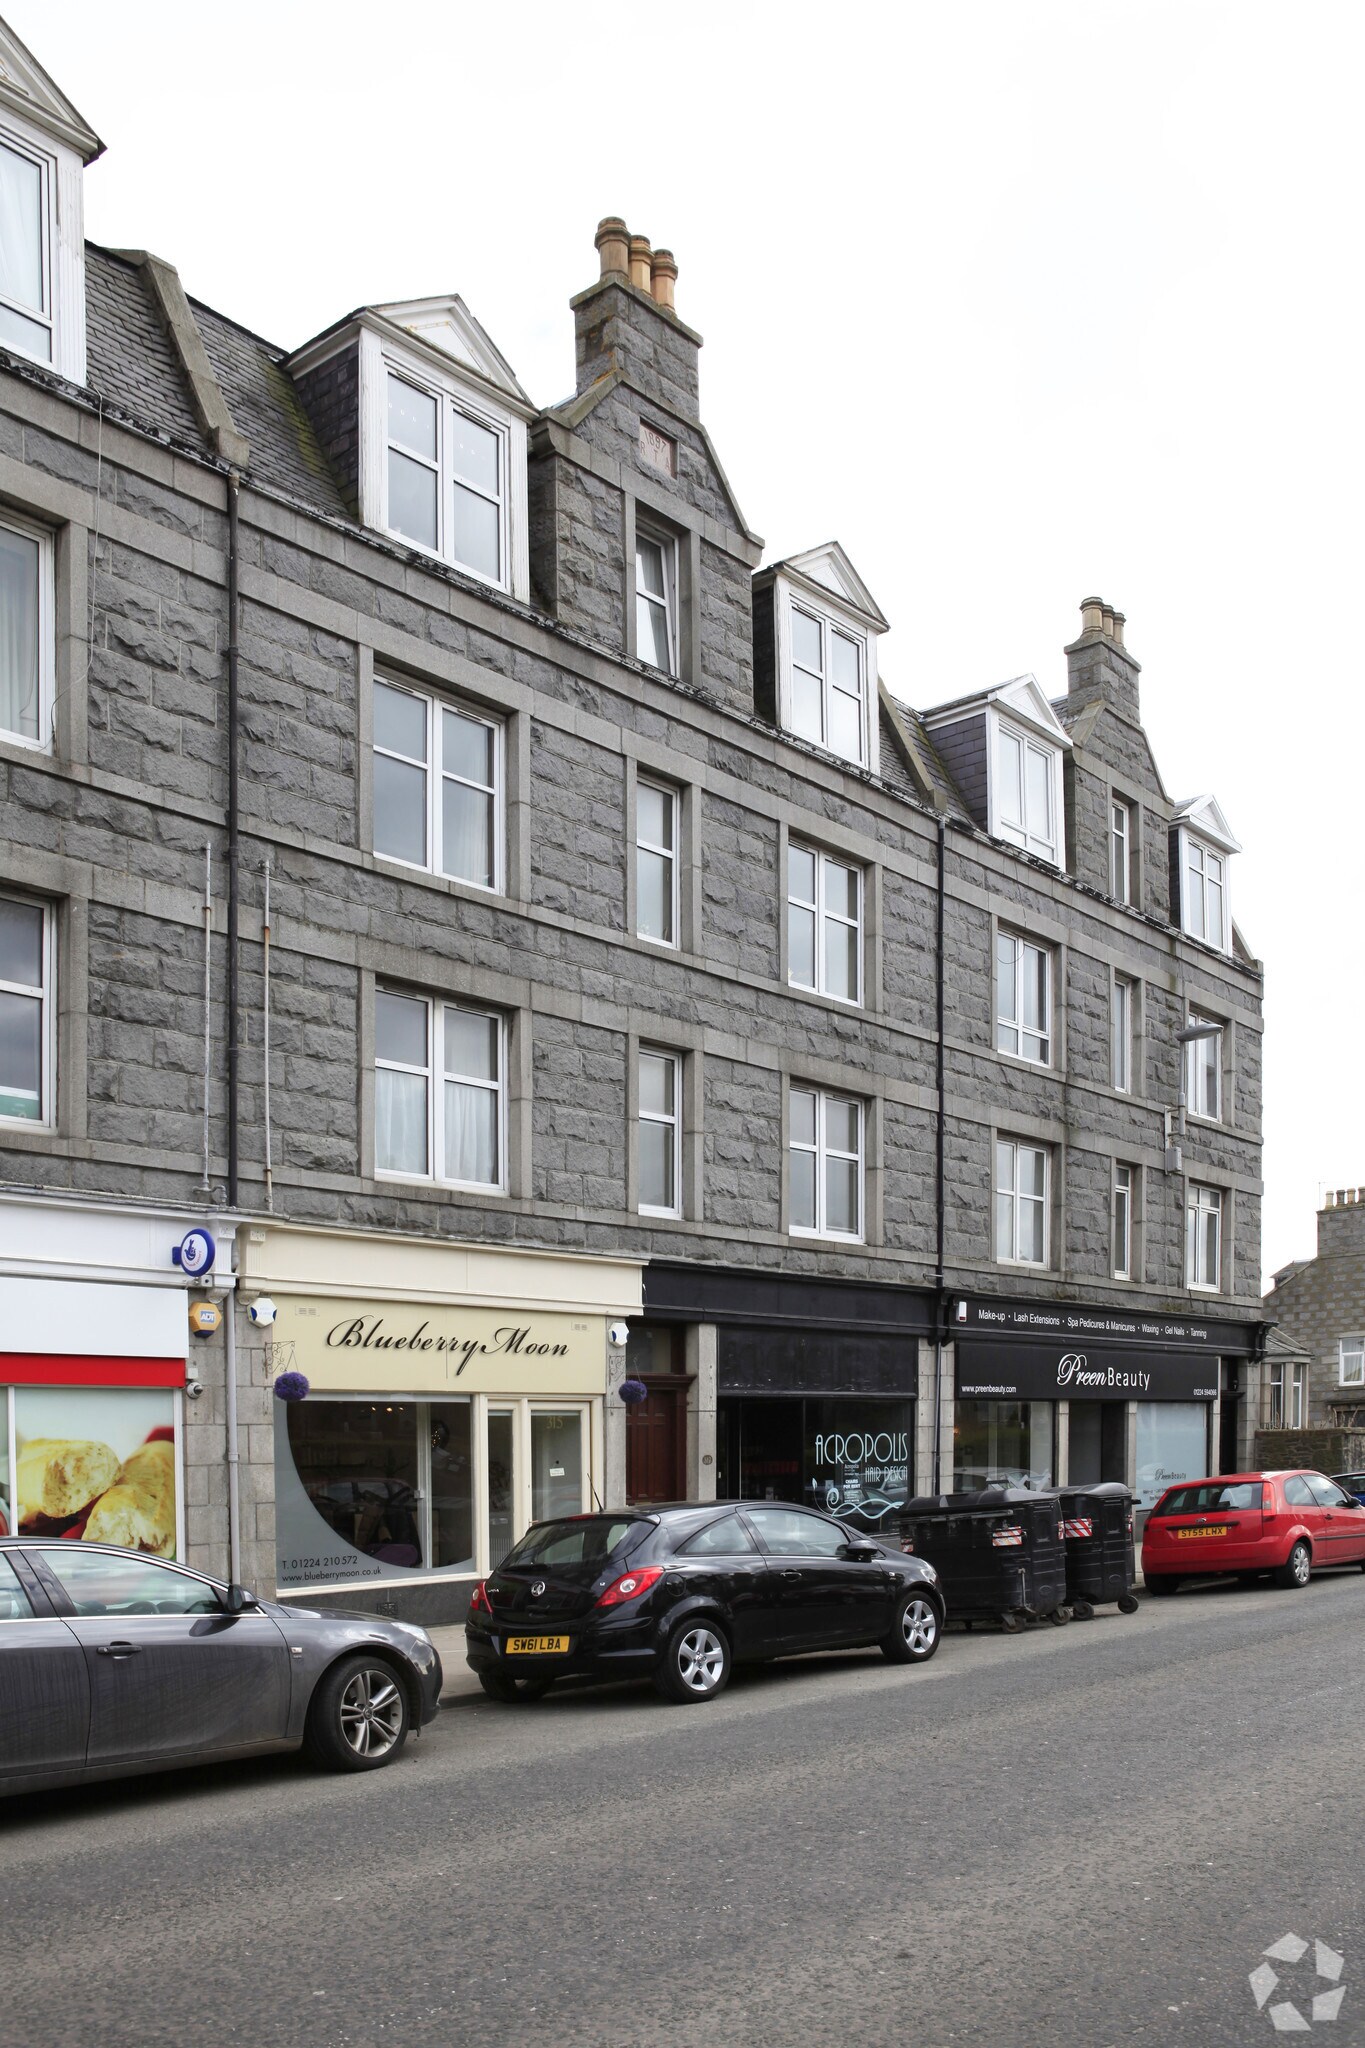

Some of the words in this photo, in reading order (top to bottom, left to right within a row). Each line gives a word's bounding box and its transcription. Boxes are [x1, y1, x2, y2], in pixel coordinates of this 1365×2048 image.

[644, 430, 667, 453] 1897
[200, 1312, 215, 1321] ADT
[978, 1309, 1005, 1322] Make-up
[1013, 1312, 1029, 1323] Lash
[1029, 1313, 1060, 1326] Extensions
[1067, 1317, 1079, 1328] Spa
[1079, 1318, 1105, 1330] Pedicures
[1106, 1321, 1110, 1330] &
[1110, 1321, 1136, 1332] Manicures
[1142, 1324, 1159, 1335] Waxing
[1164, 1326, 1174, 1335] Gel
[1174, 1327, 1185, 1336] Nails
[1190, 1328, 1207, 1339] Tanning
[326, 1314, 481, 1377] Blueberry
[481, 1326, 570, 1357] Moon
[961, 1384, 1017, 1394] www.preenbeauty.com
[815, 1432, 908, 1465] ACROPOLIS
[865, 1466, 881, 1483] HAIR
[883, 1465, 908, 1482] DESIGN
[1181, 1528, 1204, 1537] ST55
[291, 1558, 320, 1569] 01224
[282, 1566, 382, 1582] www.blueberrymoon.co.uk
[513, 1638, 537, 1651] SW61
[539, 1638, 561, 1650] LBA
